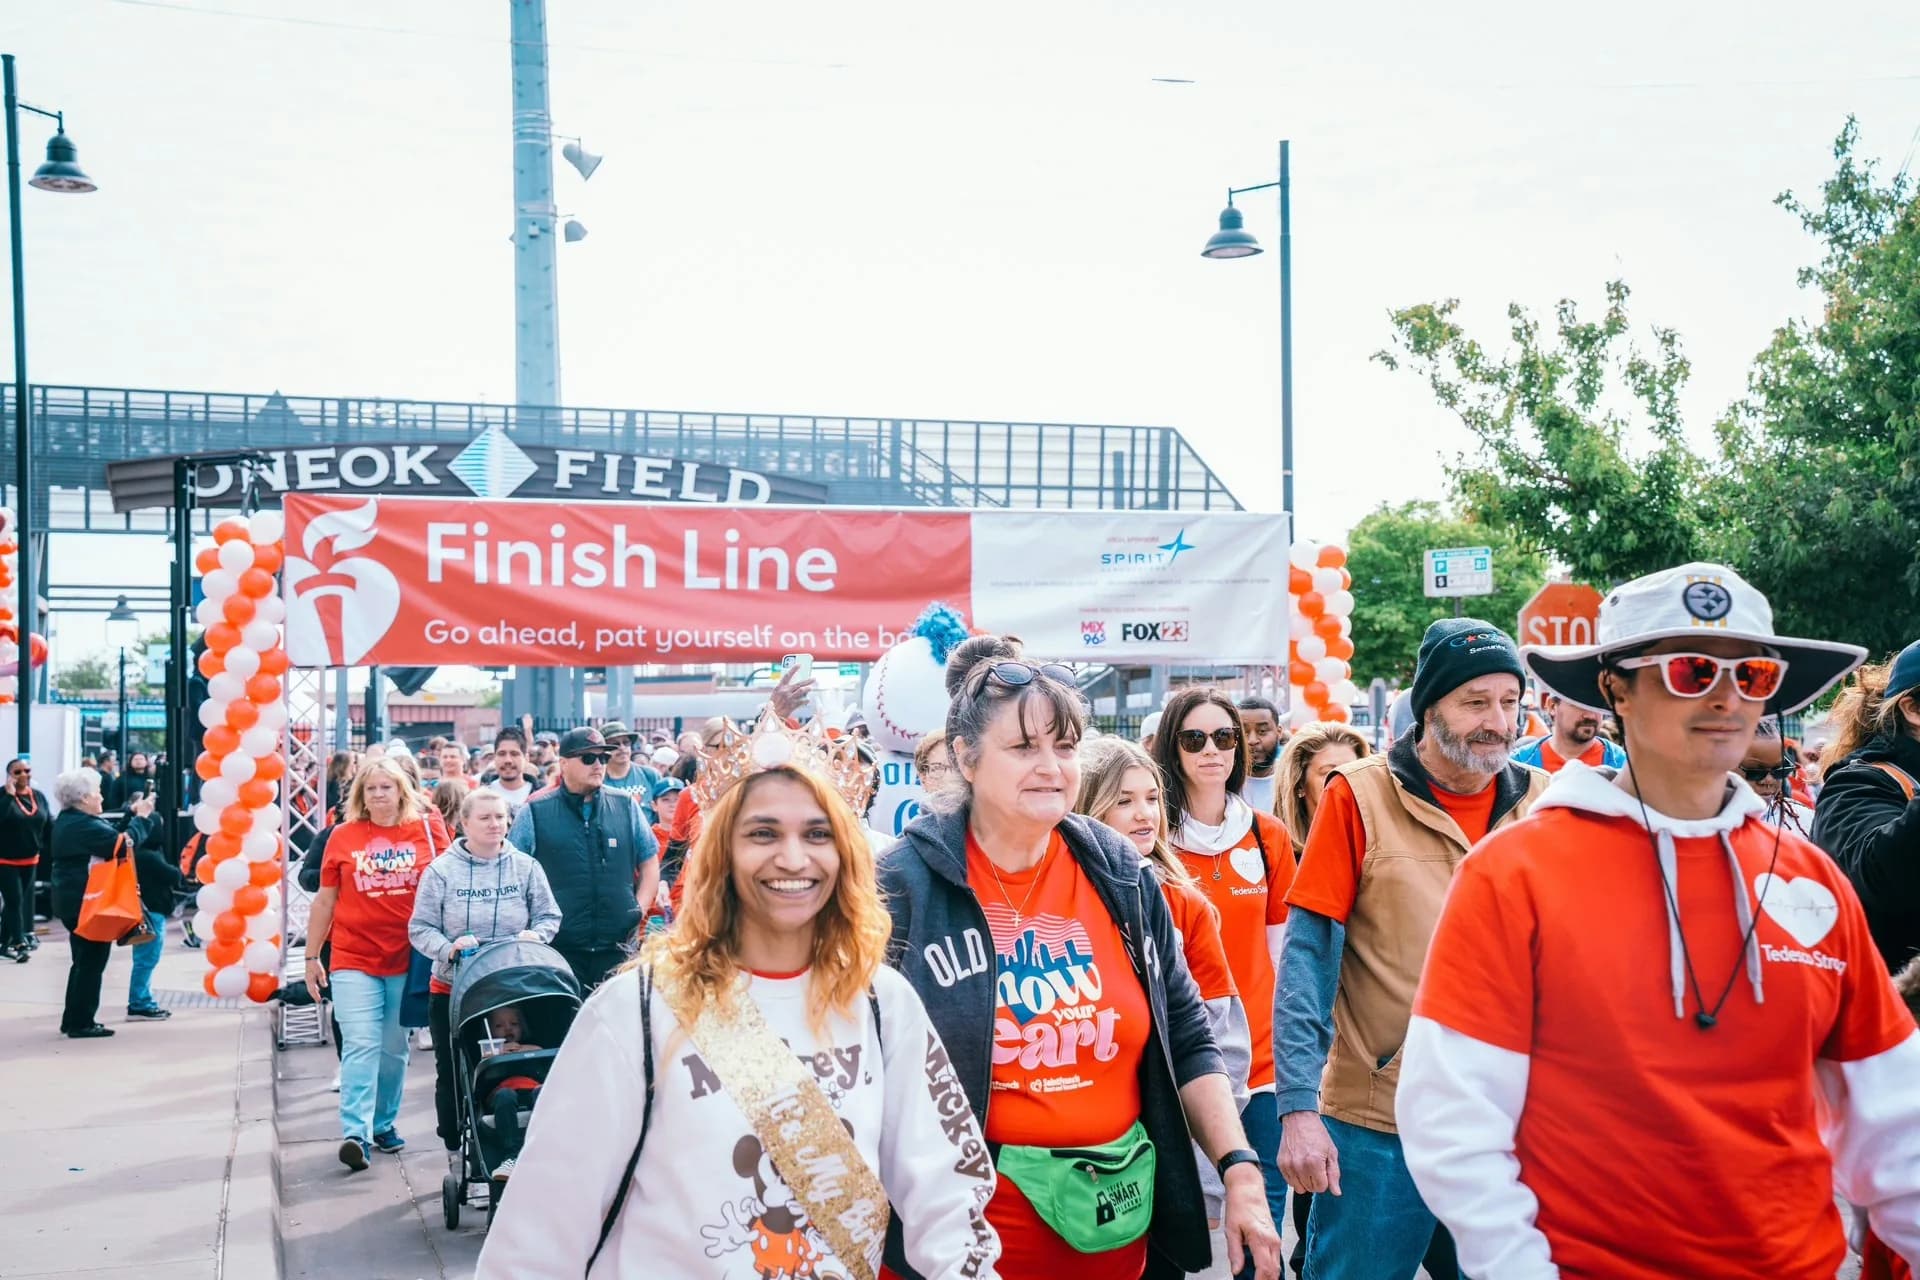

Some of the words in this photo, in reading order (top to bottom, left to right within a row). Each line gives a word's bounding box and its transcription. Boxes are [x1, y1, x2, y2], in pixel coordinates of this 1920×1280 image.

[554, 449, 772, 504] FIELD
[427, 520, 657, 589] Finish
[684, 529, 838, 592] Line
[1100, 553, 1164, 565] SPIRIT
[424, 619, 470, 644] Go
[478, 620, 586, 650] ahead,
[595, 624, 646, 652] pat
[655, 624, 773, 653] yourself
[780, 632, 816, 648] on
[824, 624, 870, 648] the
[878, 624, 911, 649] ba
[1081, 621, 1105, 633] MIX
[456, 888, 492, 897] GRAND
[923, 927, 989, 988] OLD
[996, 962, 1103, 1015] now
[1051, 1003, 1097, 1027] your
[991, 1007, 1121, 1071] eart
[1109, 1181, 1141, 1206] SMART
